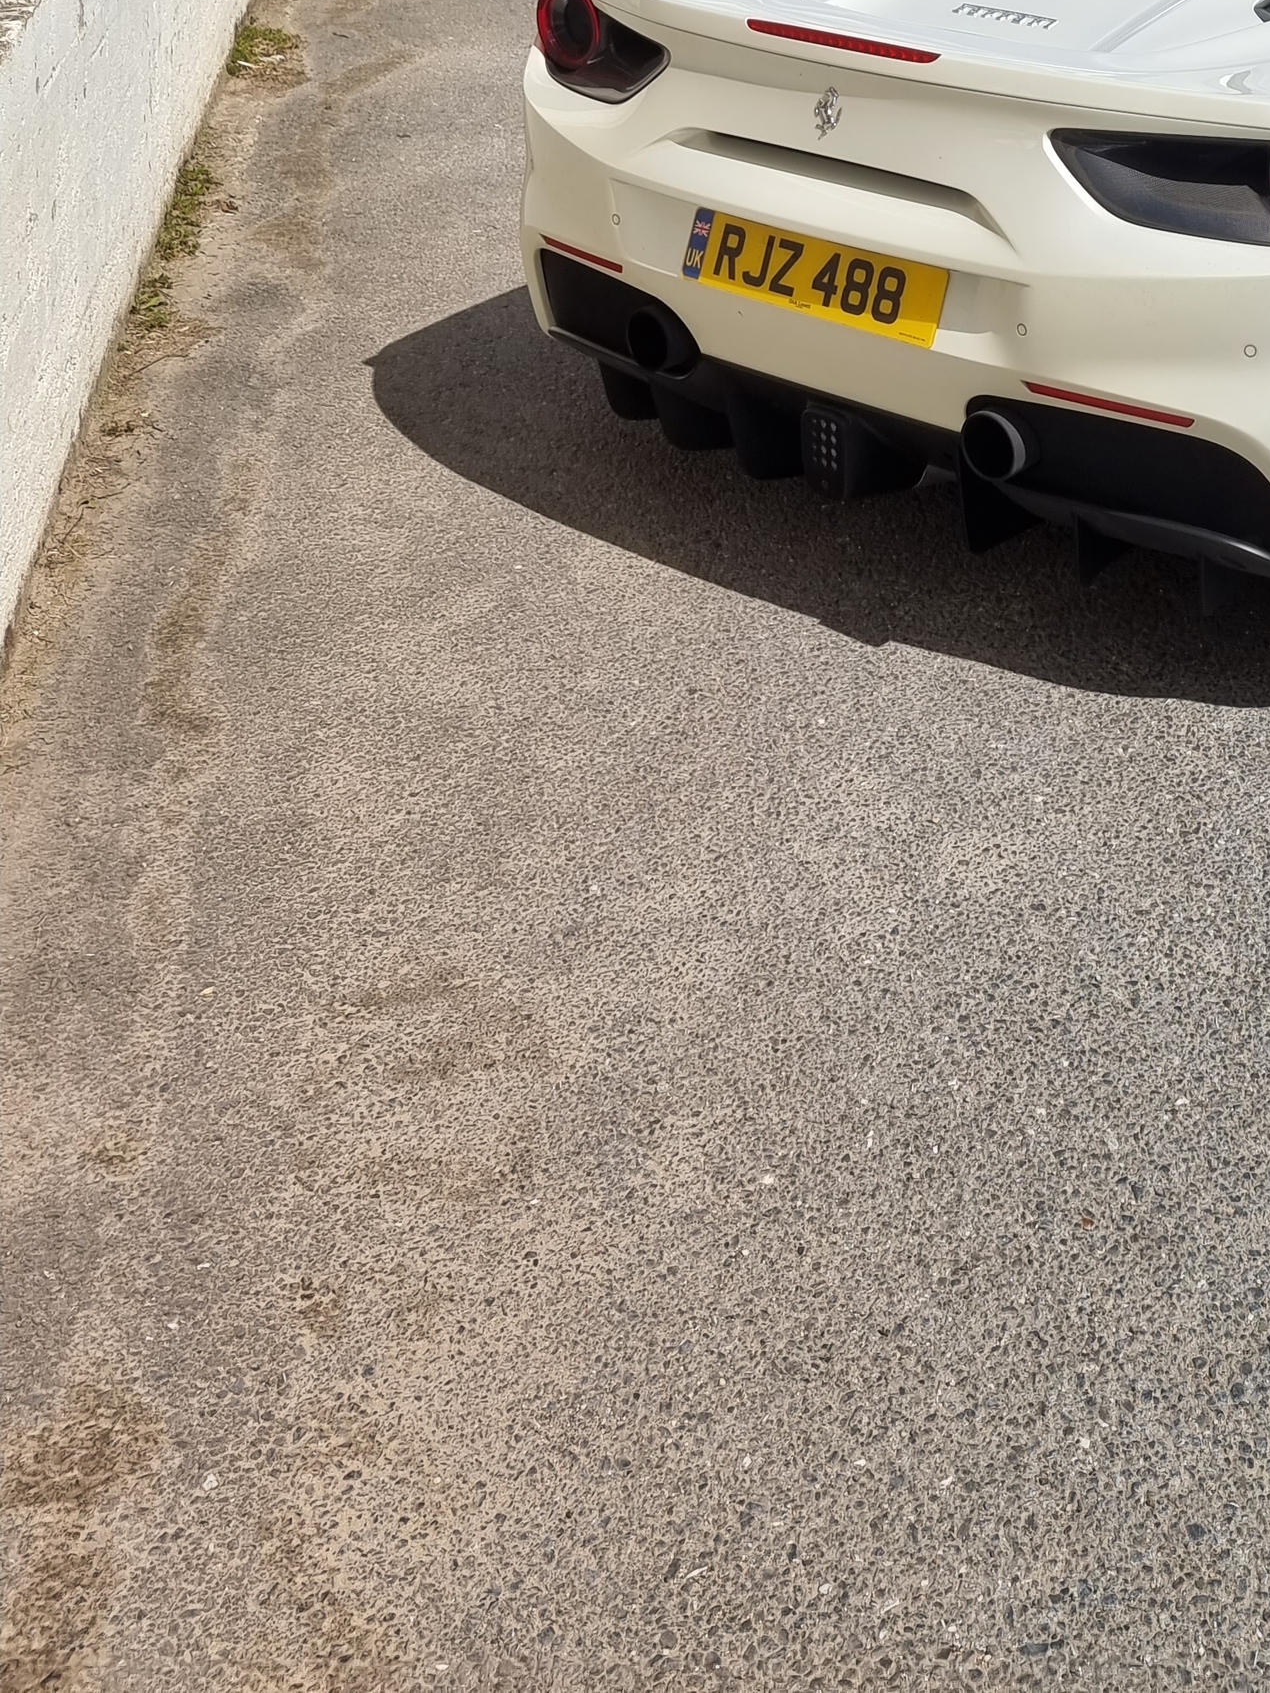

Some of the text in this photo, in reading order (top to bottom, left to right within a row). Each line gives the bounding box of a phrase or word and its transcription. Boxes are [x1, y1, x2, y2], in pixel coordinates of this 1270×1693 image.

[685, 247, 704, 269] UK
[713, 223, 907, 325] RJZ 488
